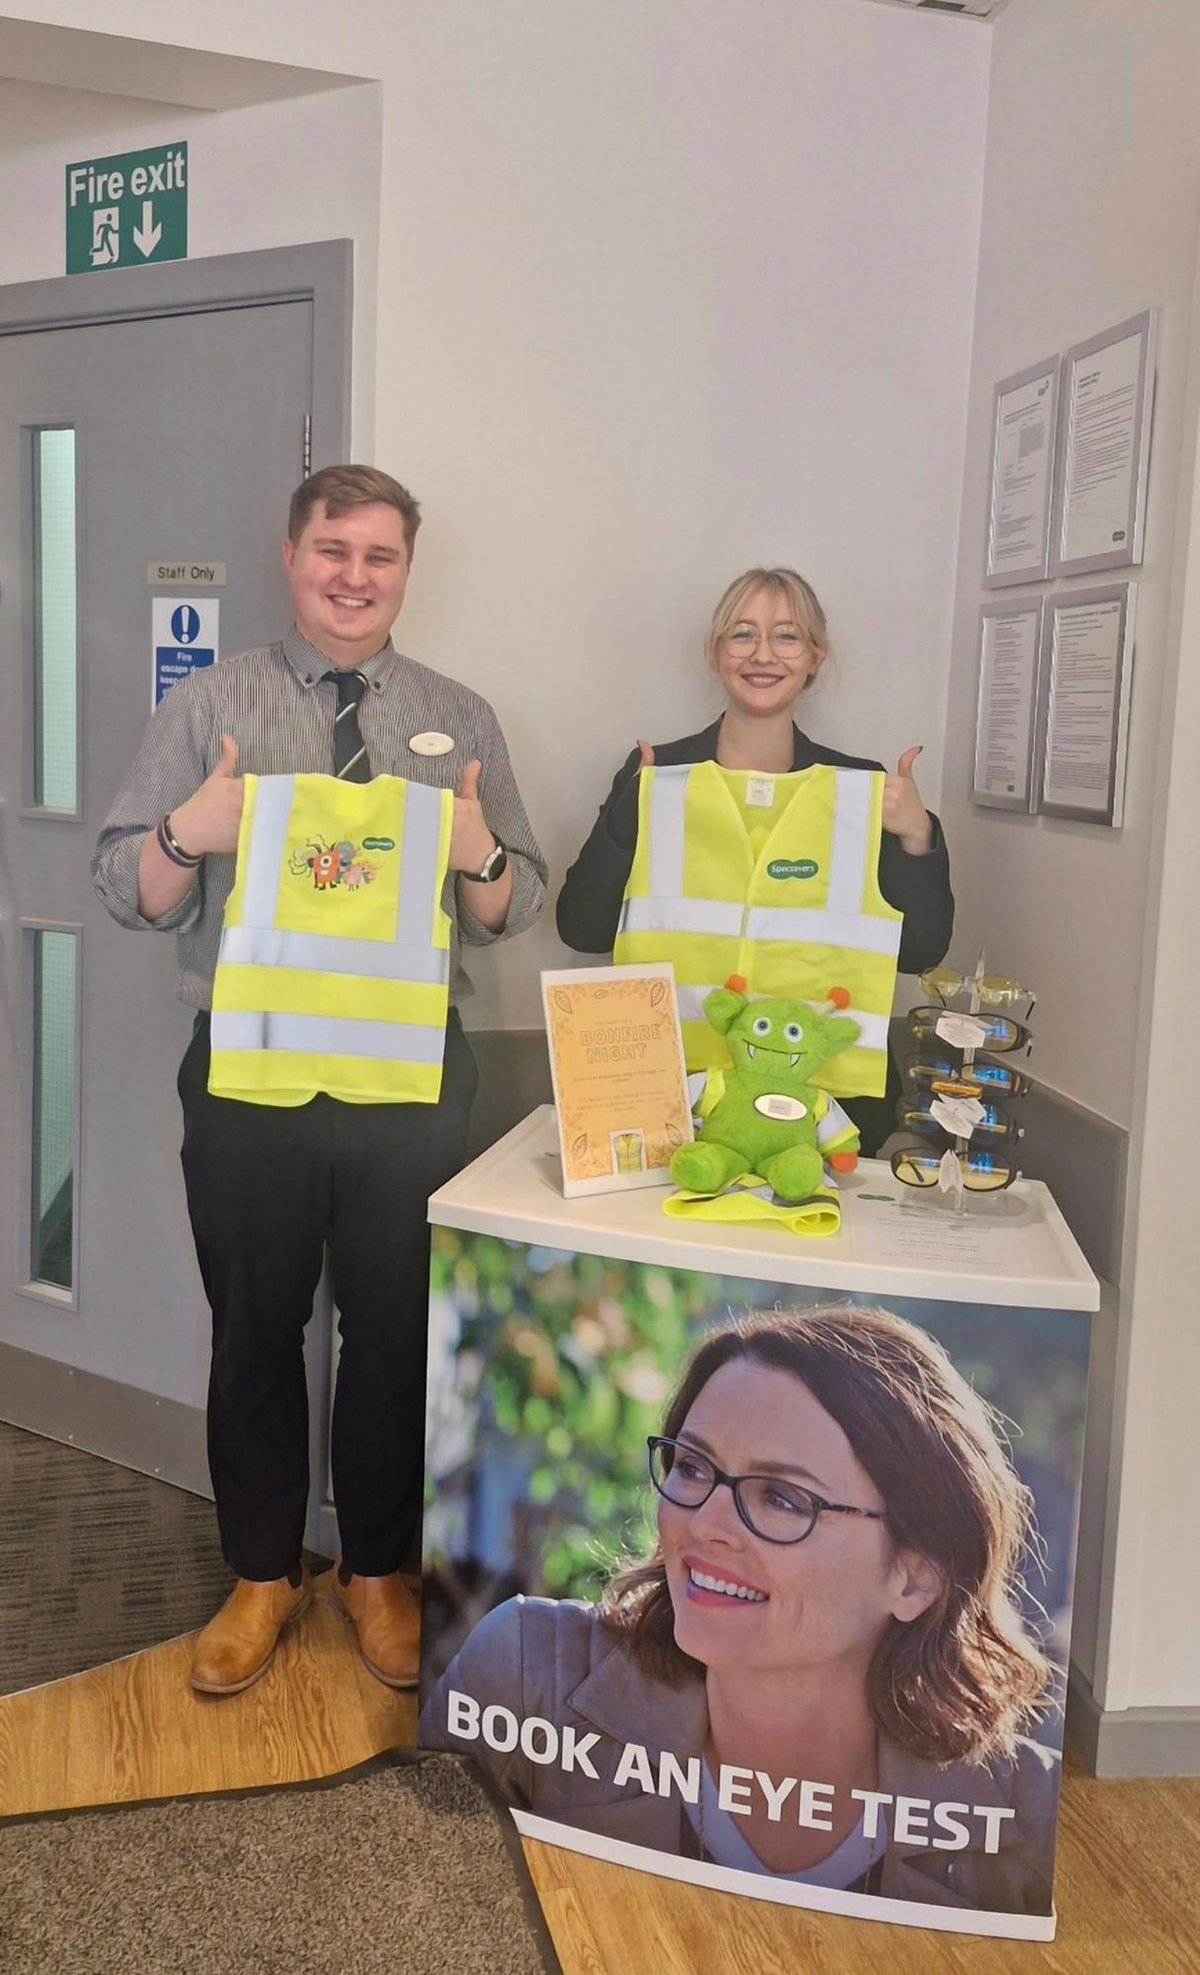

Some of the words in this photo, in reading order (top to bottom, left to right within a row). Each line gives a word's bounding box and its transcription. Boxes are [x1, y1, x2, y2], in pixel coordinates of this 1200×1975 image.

[71, 167, 124, 207] Fire
[131, 151, 185, 196] exit
[158, 566, 186, 579] Staff
[191, 566, 215, 582] Only
[177, 652, 193, 662] Fire
[771, 864, 815, 874] Specsavers
[580, 1023, 662, 1047] BONFIRE
[587, 1042, 648, 1065] NIGHT
[446, 1690, 601, 1781] BOOK
[613, 1742, 700, 1804] AN
[717, 1764, 834, 1832] EYE
[851, 1789, 1015, 1855] TEST
